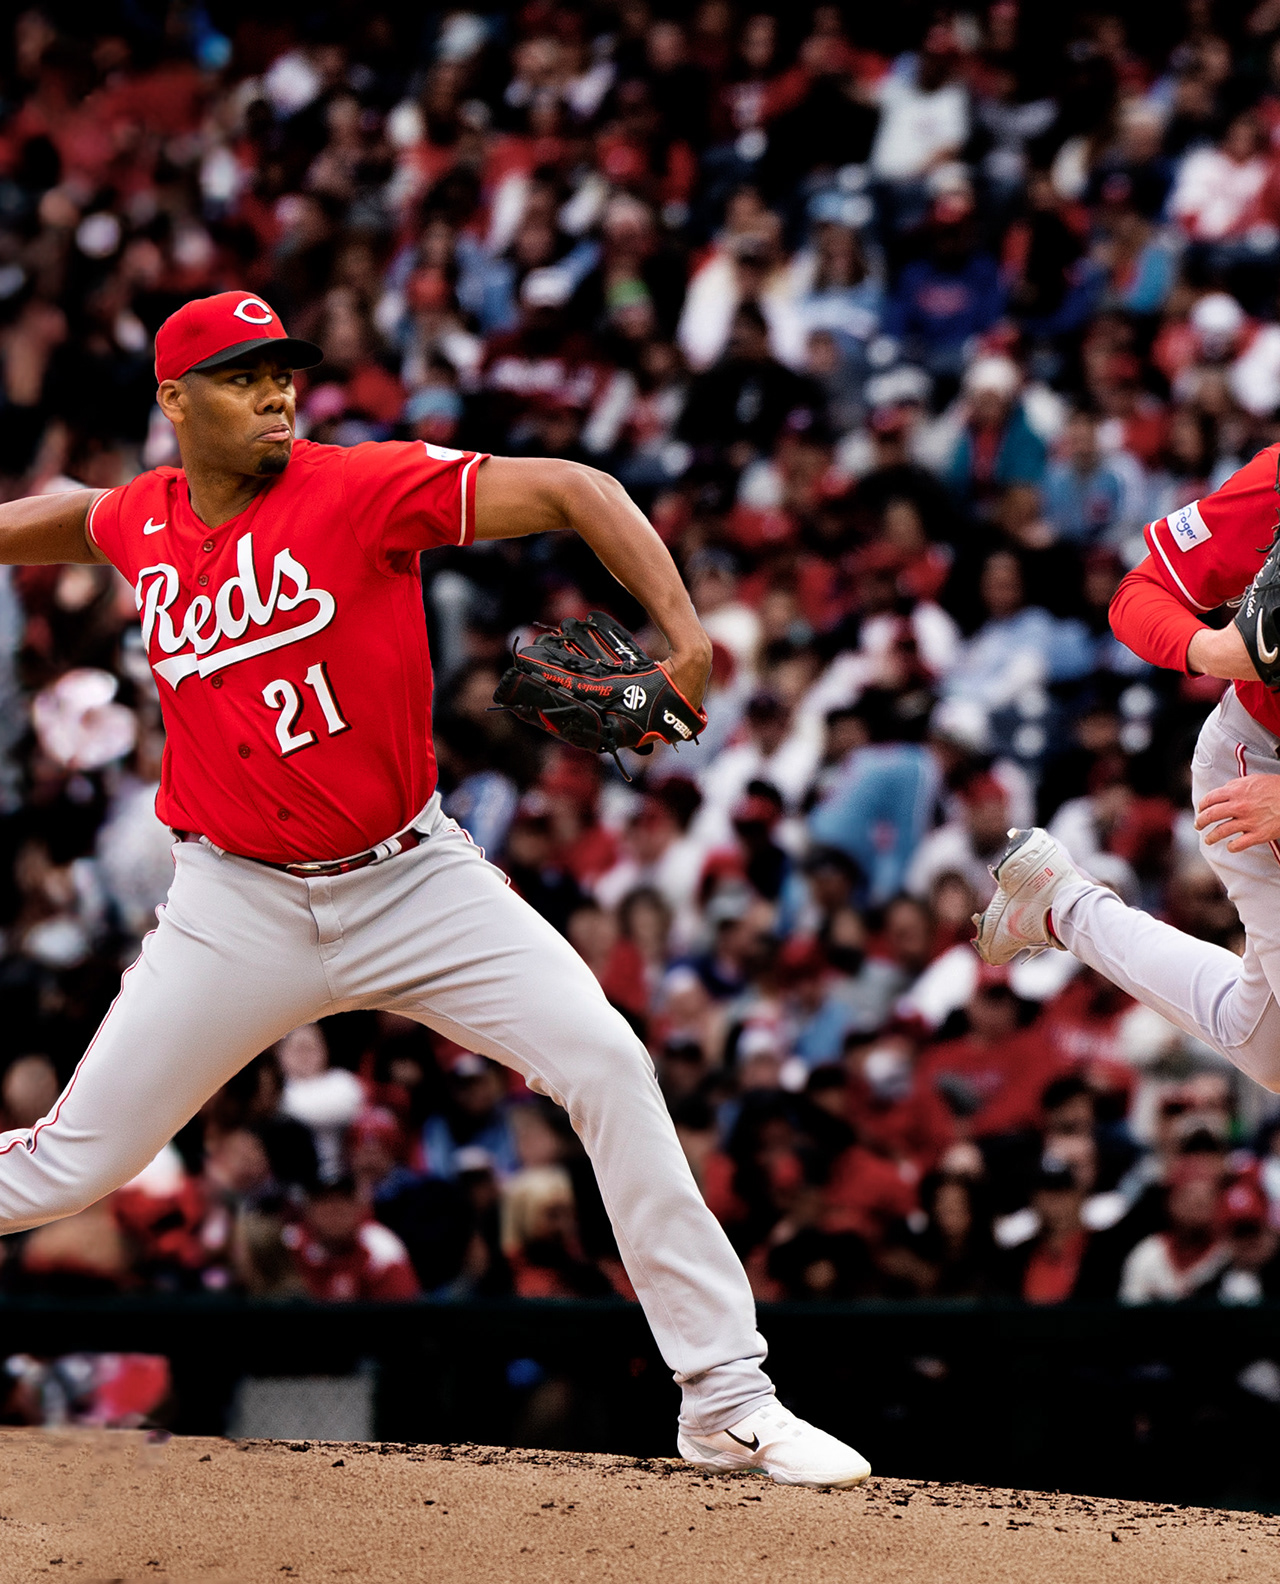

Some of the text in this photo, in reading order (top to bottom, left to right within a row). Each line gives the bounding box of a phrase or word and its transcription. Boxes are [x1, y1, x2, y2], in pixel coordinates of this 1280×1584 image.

[233, 298, 273, 325] C
[1177, 507, 1198, 540] roger
[135, 532, 336, 662] Reds
[262, 661, 352, 757] 21
